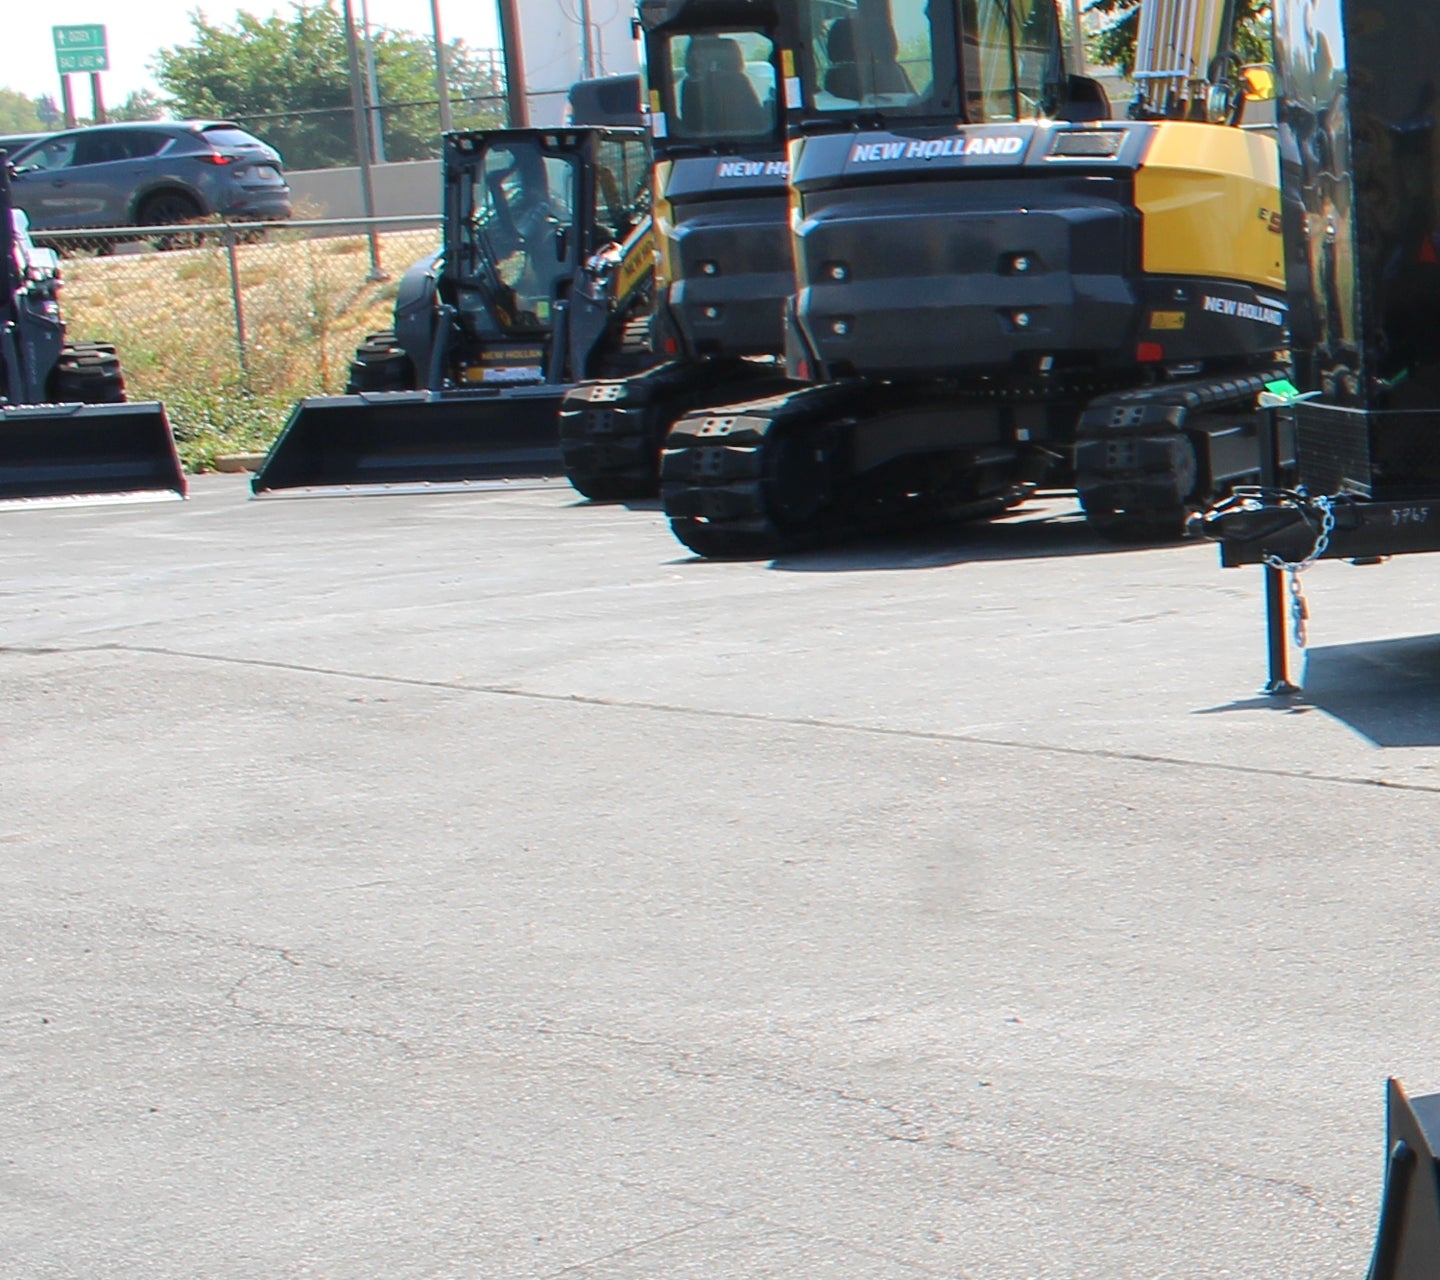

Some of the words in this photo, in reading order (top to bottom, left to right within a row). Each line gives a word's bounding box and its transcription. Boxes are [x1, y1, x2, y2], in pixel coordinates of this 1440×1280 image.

[852, 141, 906, 163] NEW
[906, 137, 1026, 159] HOLLAND
[719, 161, 764, 177] NEW
[1203, 295, 1237, 316] NEW
